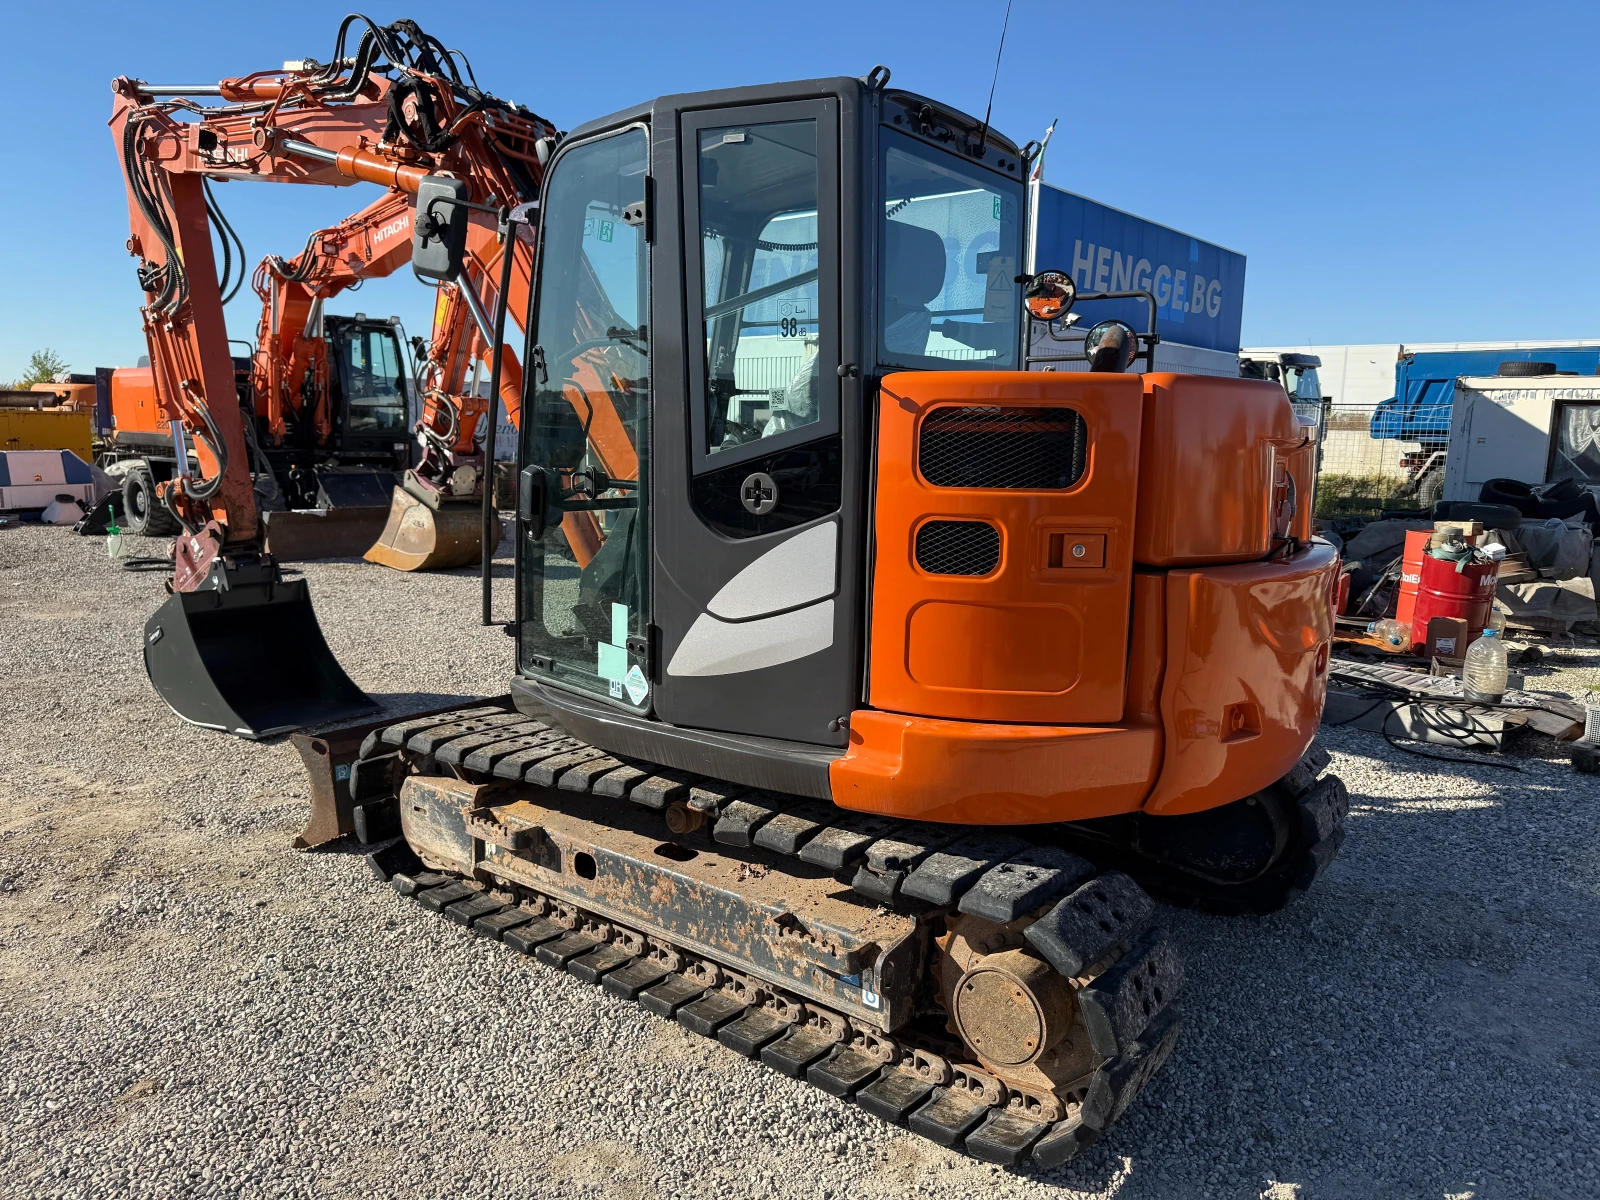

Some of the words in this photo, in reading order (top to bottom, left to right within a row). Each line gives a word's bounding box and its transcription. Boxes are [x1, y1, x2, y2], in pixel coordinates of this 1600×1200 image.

[373, 215, 409, 245] HITACHI
[1071, 239, 1222, 318] HENGGE.BG
[781, 317, 797, 338] 98
